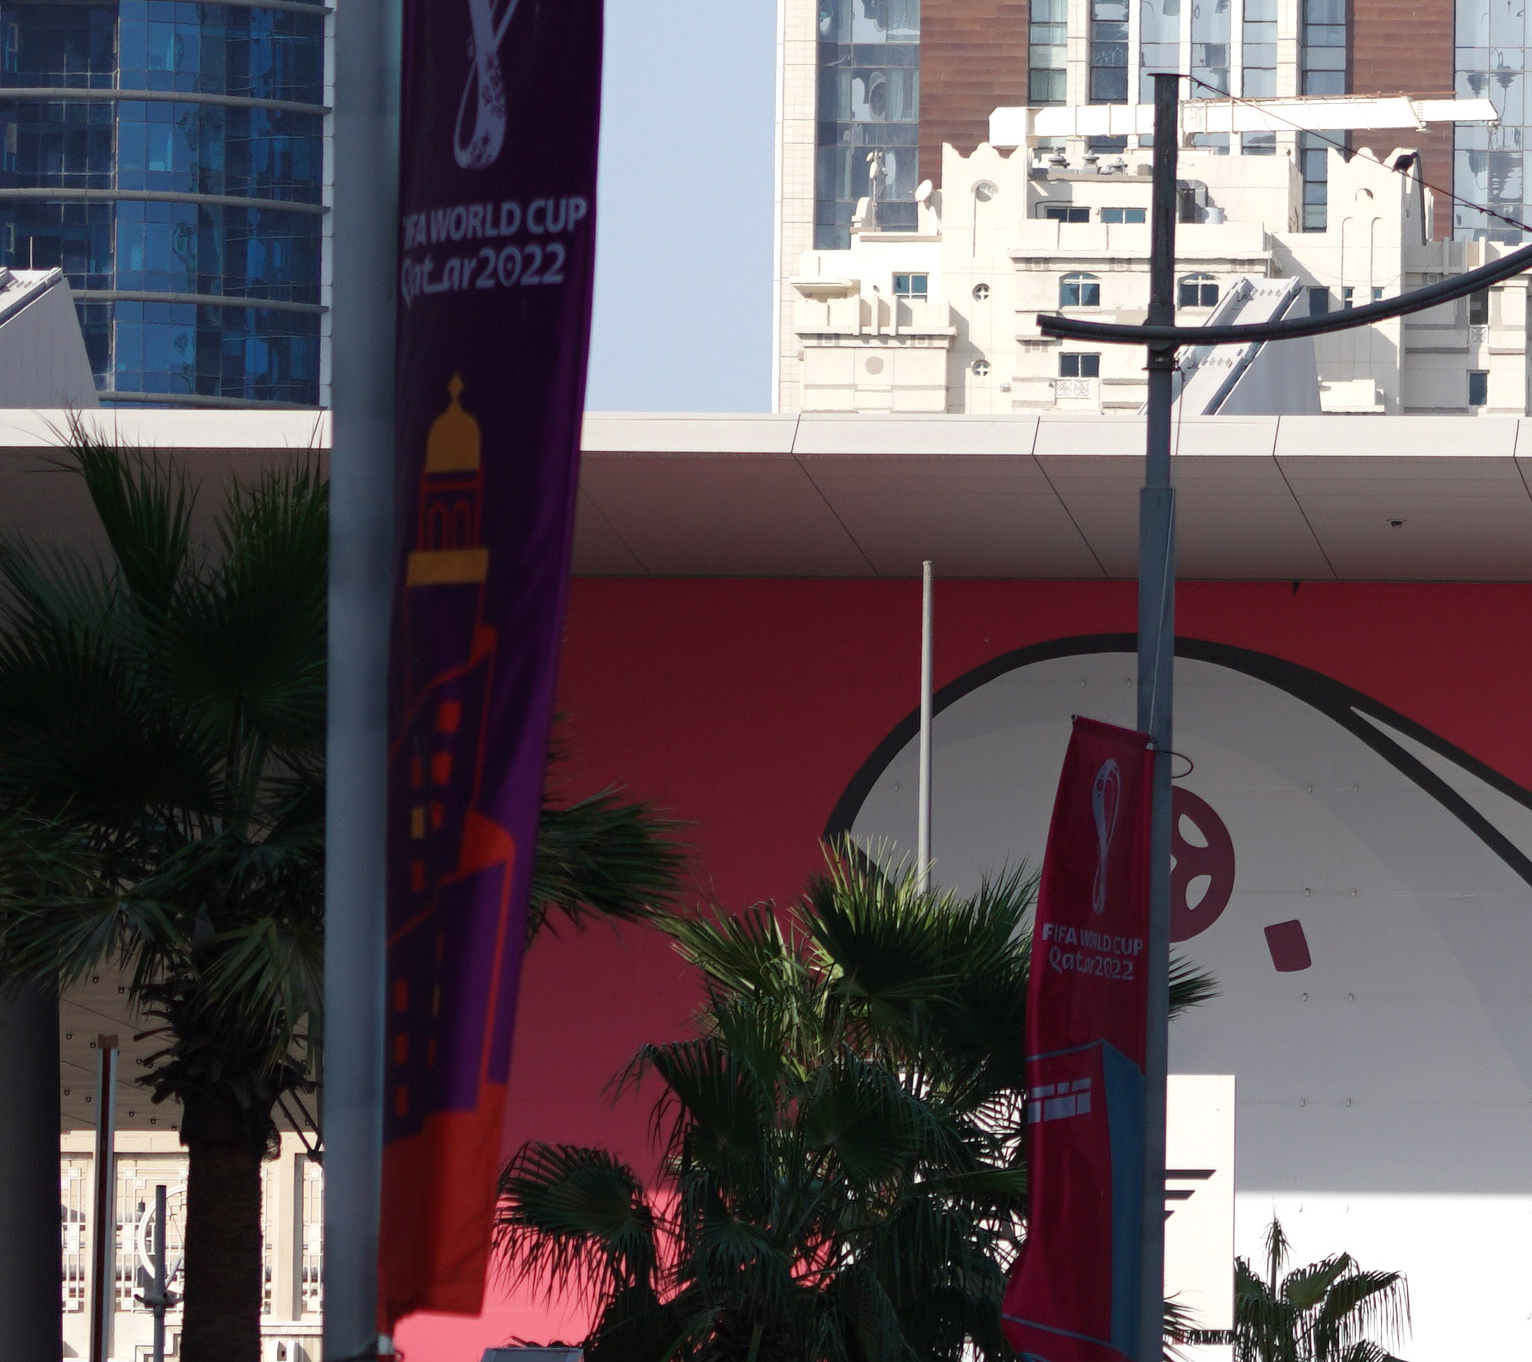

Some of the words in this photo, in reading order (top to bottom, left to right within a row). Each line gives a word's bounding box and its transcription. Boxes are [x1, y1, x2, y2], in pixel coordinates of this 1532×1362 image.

[430, 201, 521, 244] WORLD
[526, 196, 587, 235] CUP
[1042, 923, 1078, 945] FIFA
[1080, 929, 1112, 952] WORLD
[1113, 936, 1143, 956] CUP
